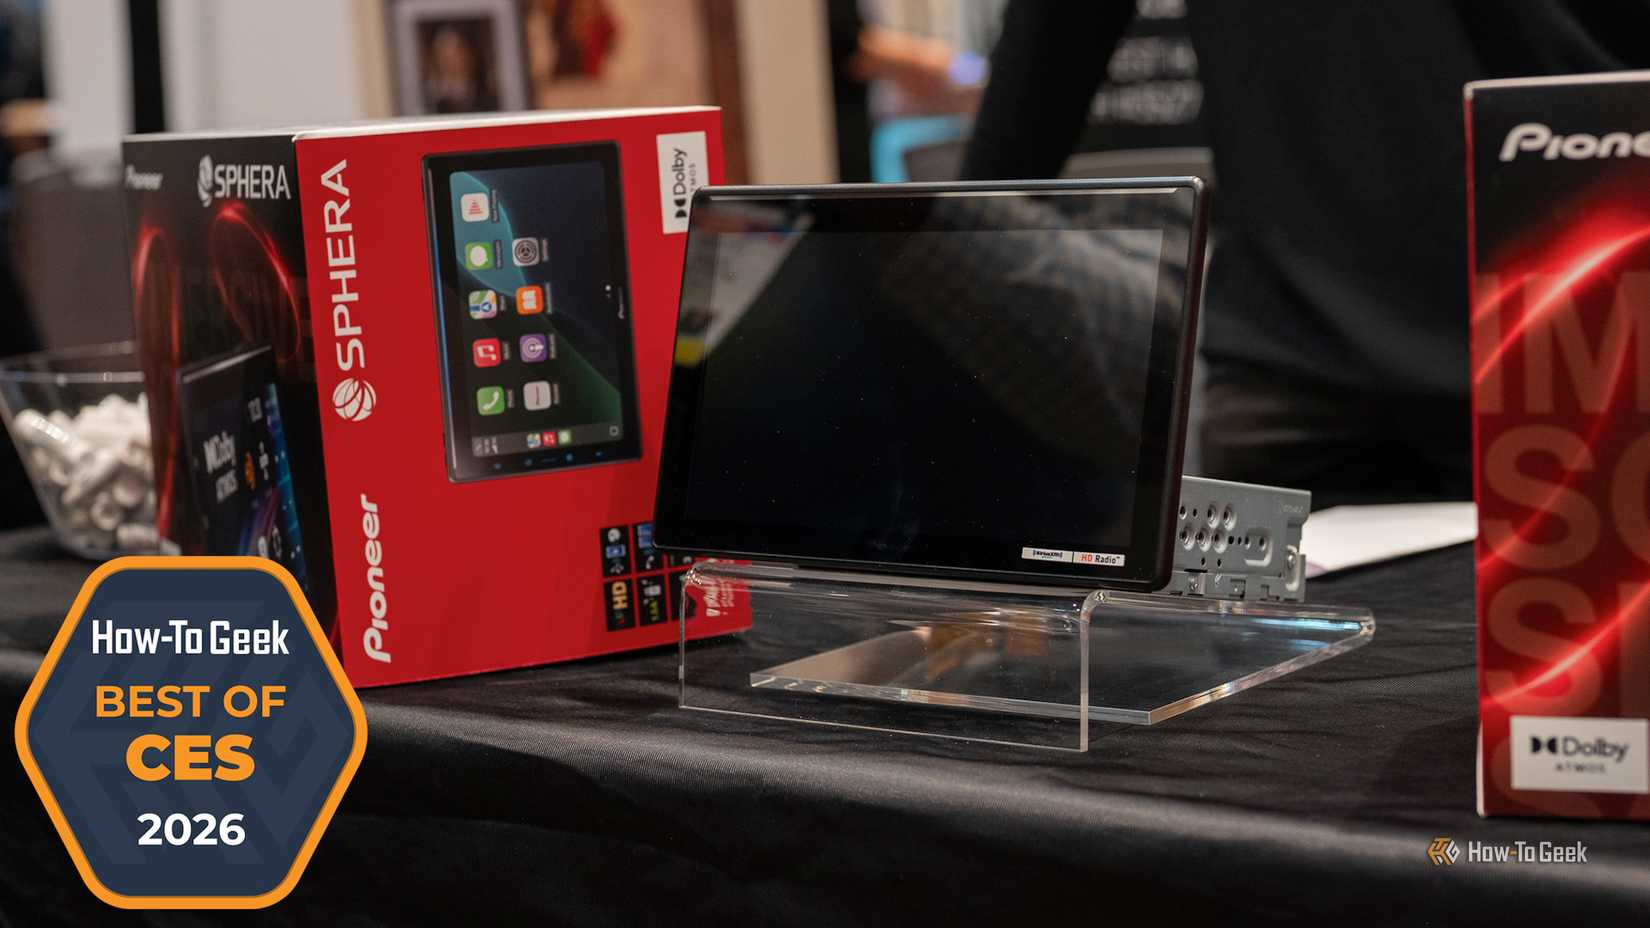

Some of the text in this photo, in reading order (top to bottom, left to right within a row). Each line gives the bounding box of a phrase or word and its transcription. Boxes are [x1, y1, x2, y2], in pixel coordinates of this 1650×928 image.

[214, 164, 291, 199] SPHERA
[672, 148, 687, 195] Dolby
[320, 158, 366, 371] SPHERA
[1080, 553, 1093, 562] HD
[360, 493, 392, 664] Pioneer
[612, 581, 627, 610] HD
[1563, 737, 1630, 763] Dolby
